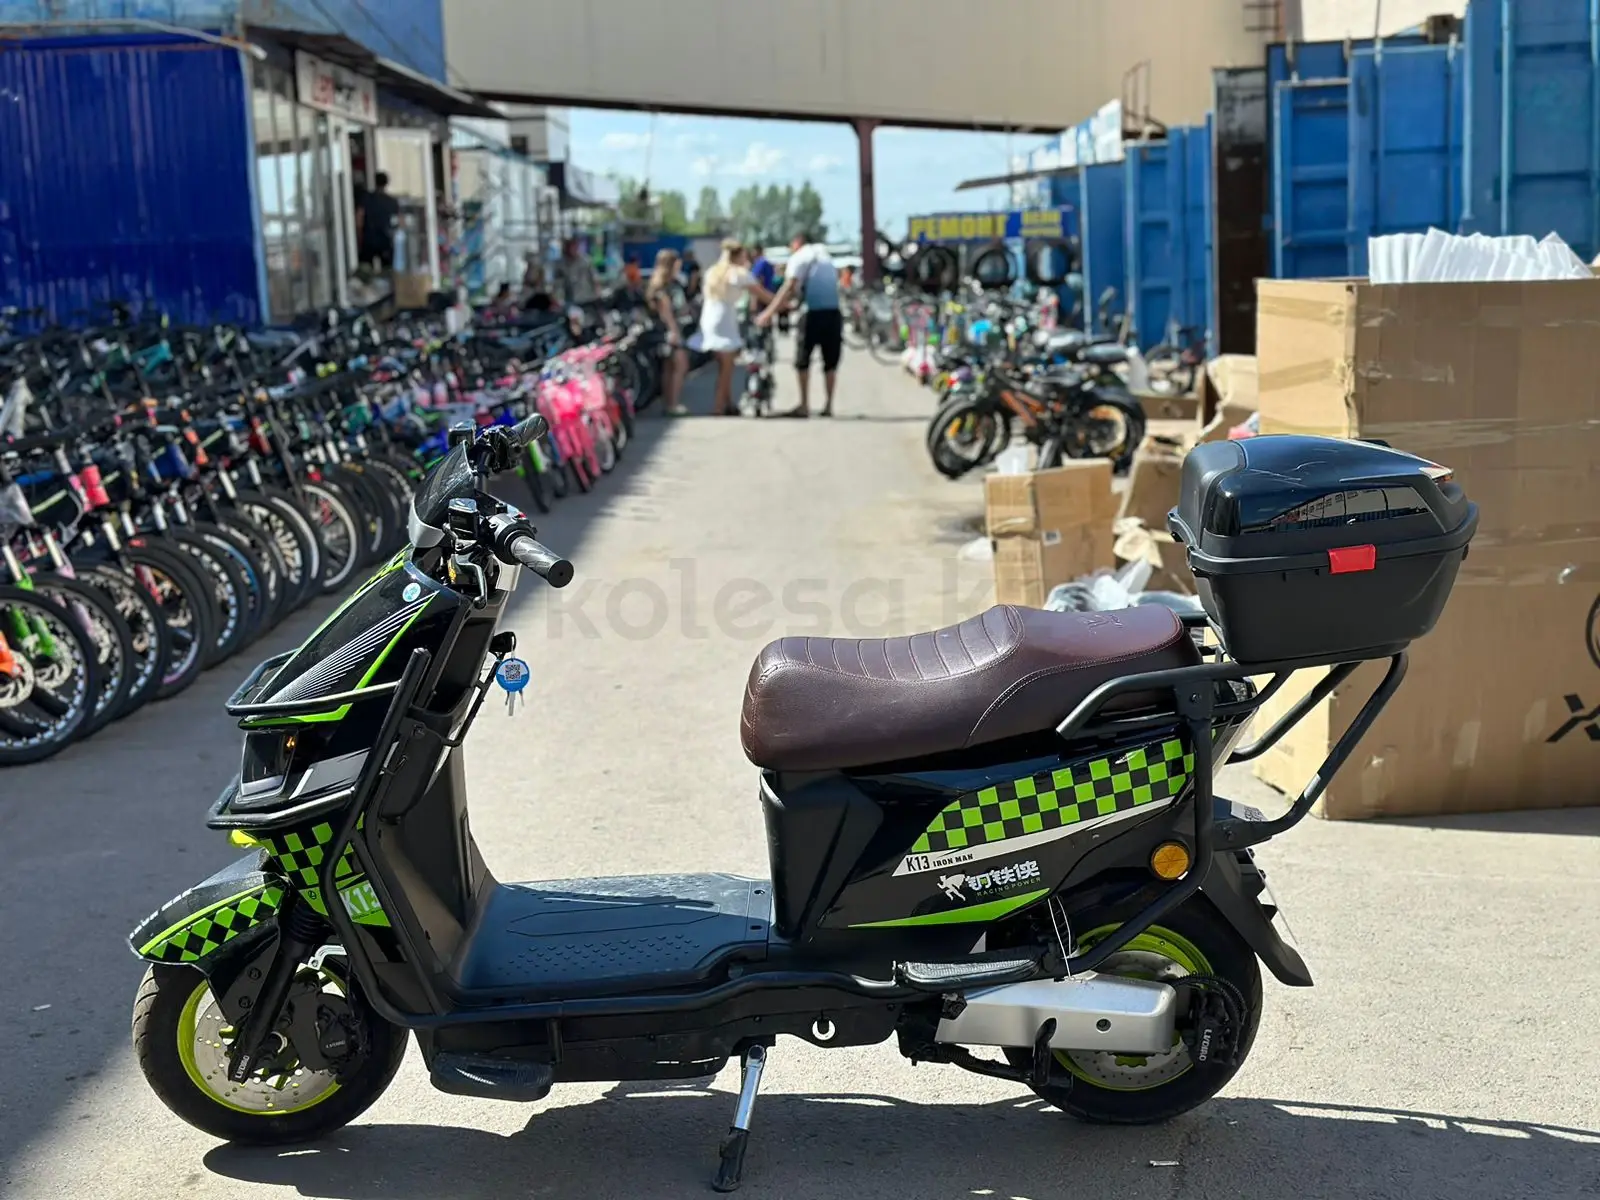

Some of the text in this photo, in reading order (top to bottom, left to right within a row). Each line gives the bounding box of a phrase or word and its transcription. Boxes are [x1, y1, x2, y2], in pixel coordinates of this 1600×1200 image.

[905, 853, 974, 872] K13 IRON MAN
